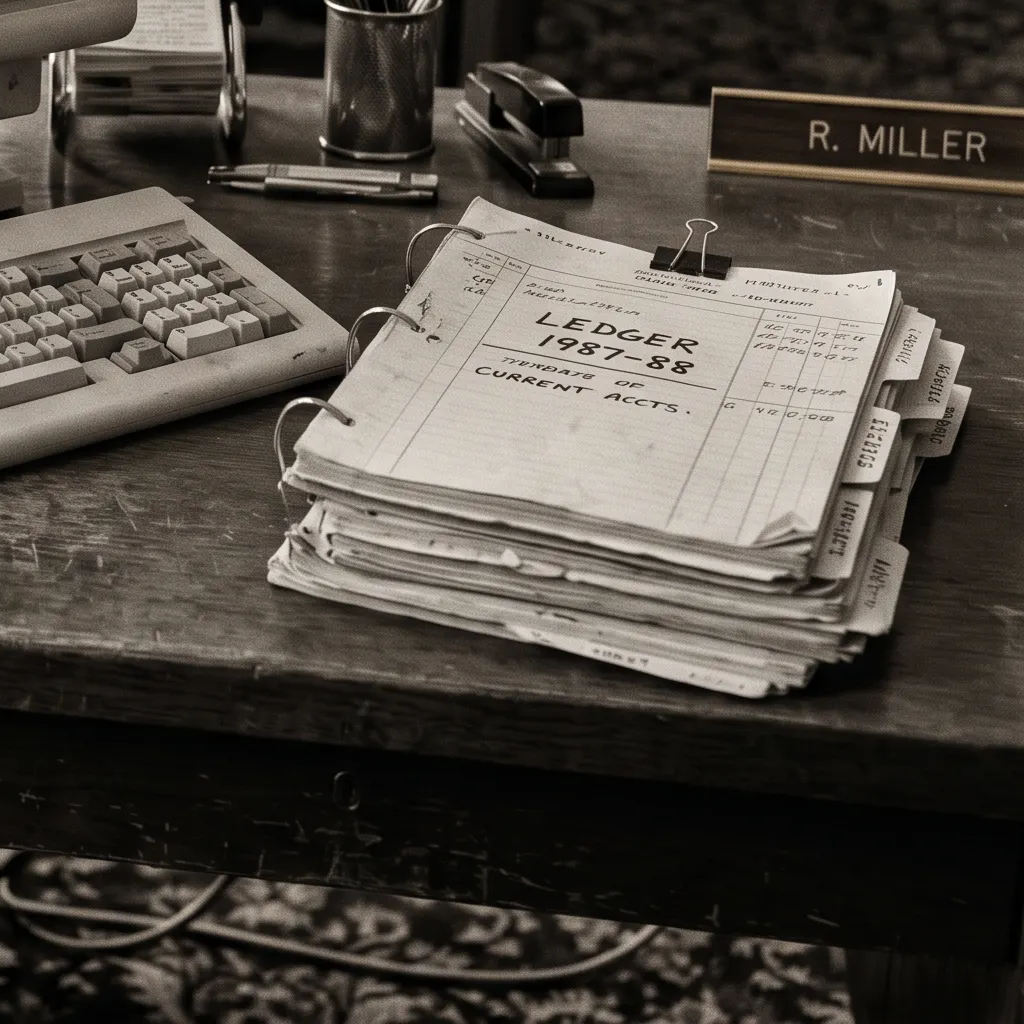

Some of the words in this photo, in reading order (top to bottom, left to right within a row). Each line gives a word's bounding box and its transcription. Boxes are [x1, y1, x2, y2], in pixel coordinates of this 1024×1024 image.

[808, 119, 839, 152] R.
[858, 123, 987, 163] MILLER
[535, 311, 700, 355] LEDGER
[538, 334, 695, 375] 1987-88
[474, 366, 595, 394] CURRENT
[603, 392, 691, 415] ACCTS.
